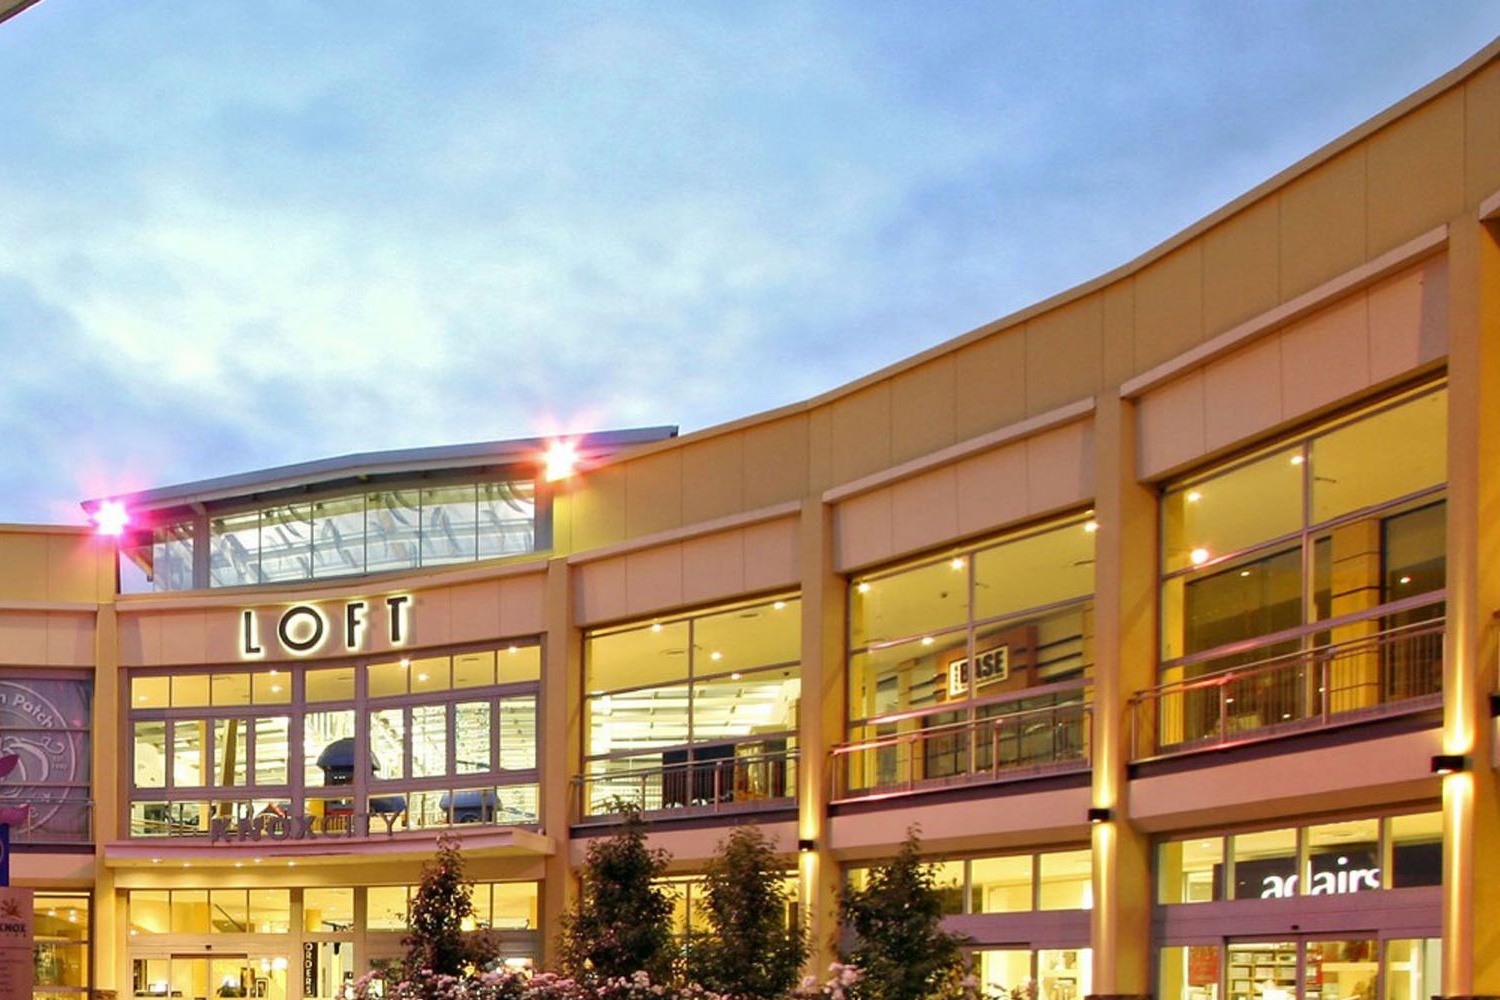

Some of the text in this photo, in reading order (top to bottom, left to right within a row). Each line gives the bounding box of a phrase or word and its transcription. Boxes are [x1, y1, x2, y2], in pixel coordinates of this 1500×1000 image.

[243, 596, 408, 654] LOFT
[12, 693, 53, 728] Patch
[304, 942, 314, 995] ORDERS
